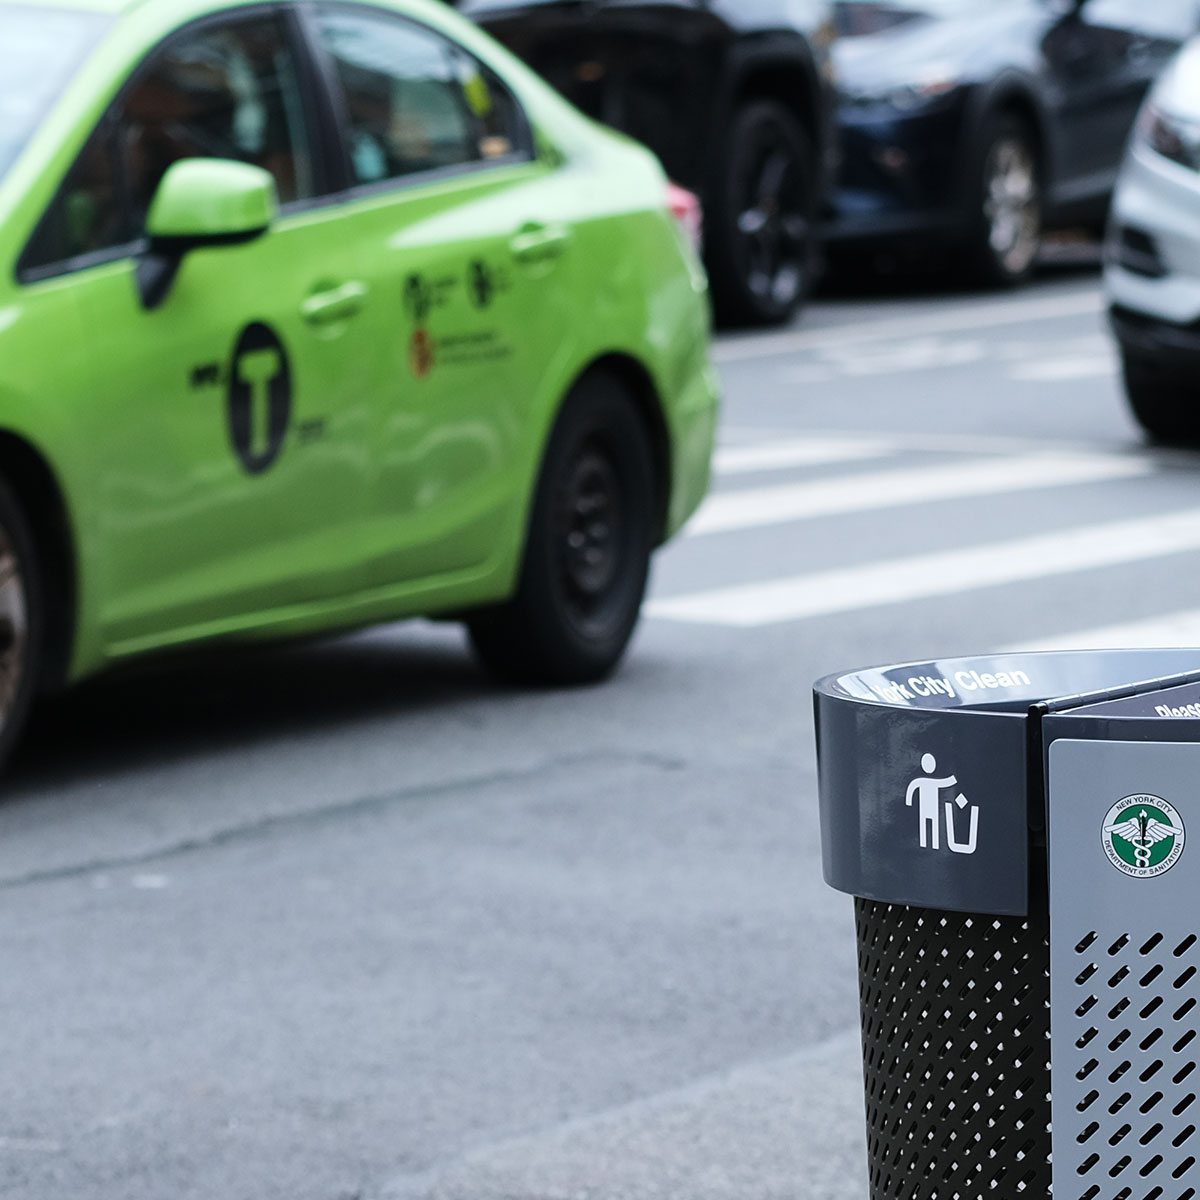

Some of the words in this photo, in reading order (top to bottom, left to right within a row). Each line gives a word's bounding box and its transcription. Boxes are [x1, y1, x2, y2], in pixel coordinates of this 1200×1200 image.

[238, 348, 279, 457] T
[908, 676, 956, 698] City
[954, 670, 1031, 691] Clean
[1115, 798, 1132, 811] NEW
[1133, 796, 1155, 804] YORK
[1156, 800, 1173, 814] CITY
[1104, 840, 1138, 875] DEPARTMENT
[1149, 842, 1181, 875] SANITATION
